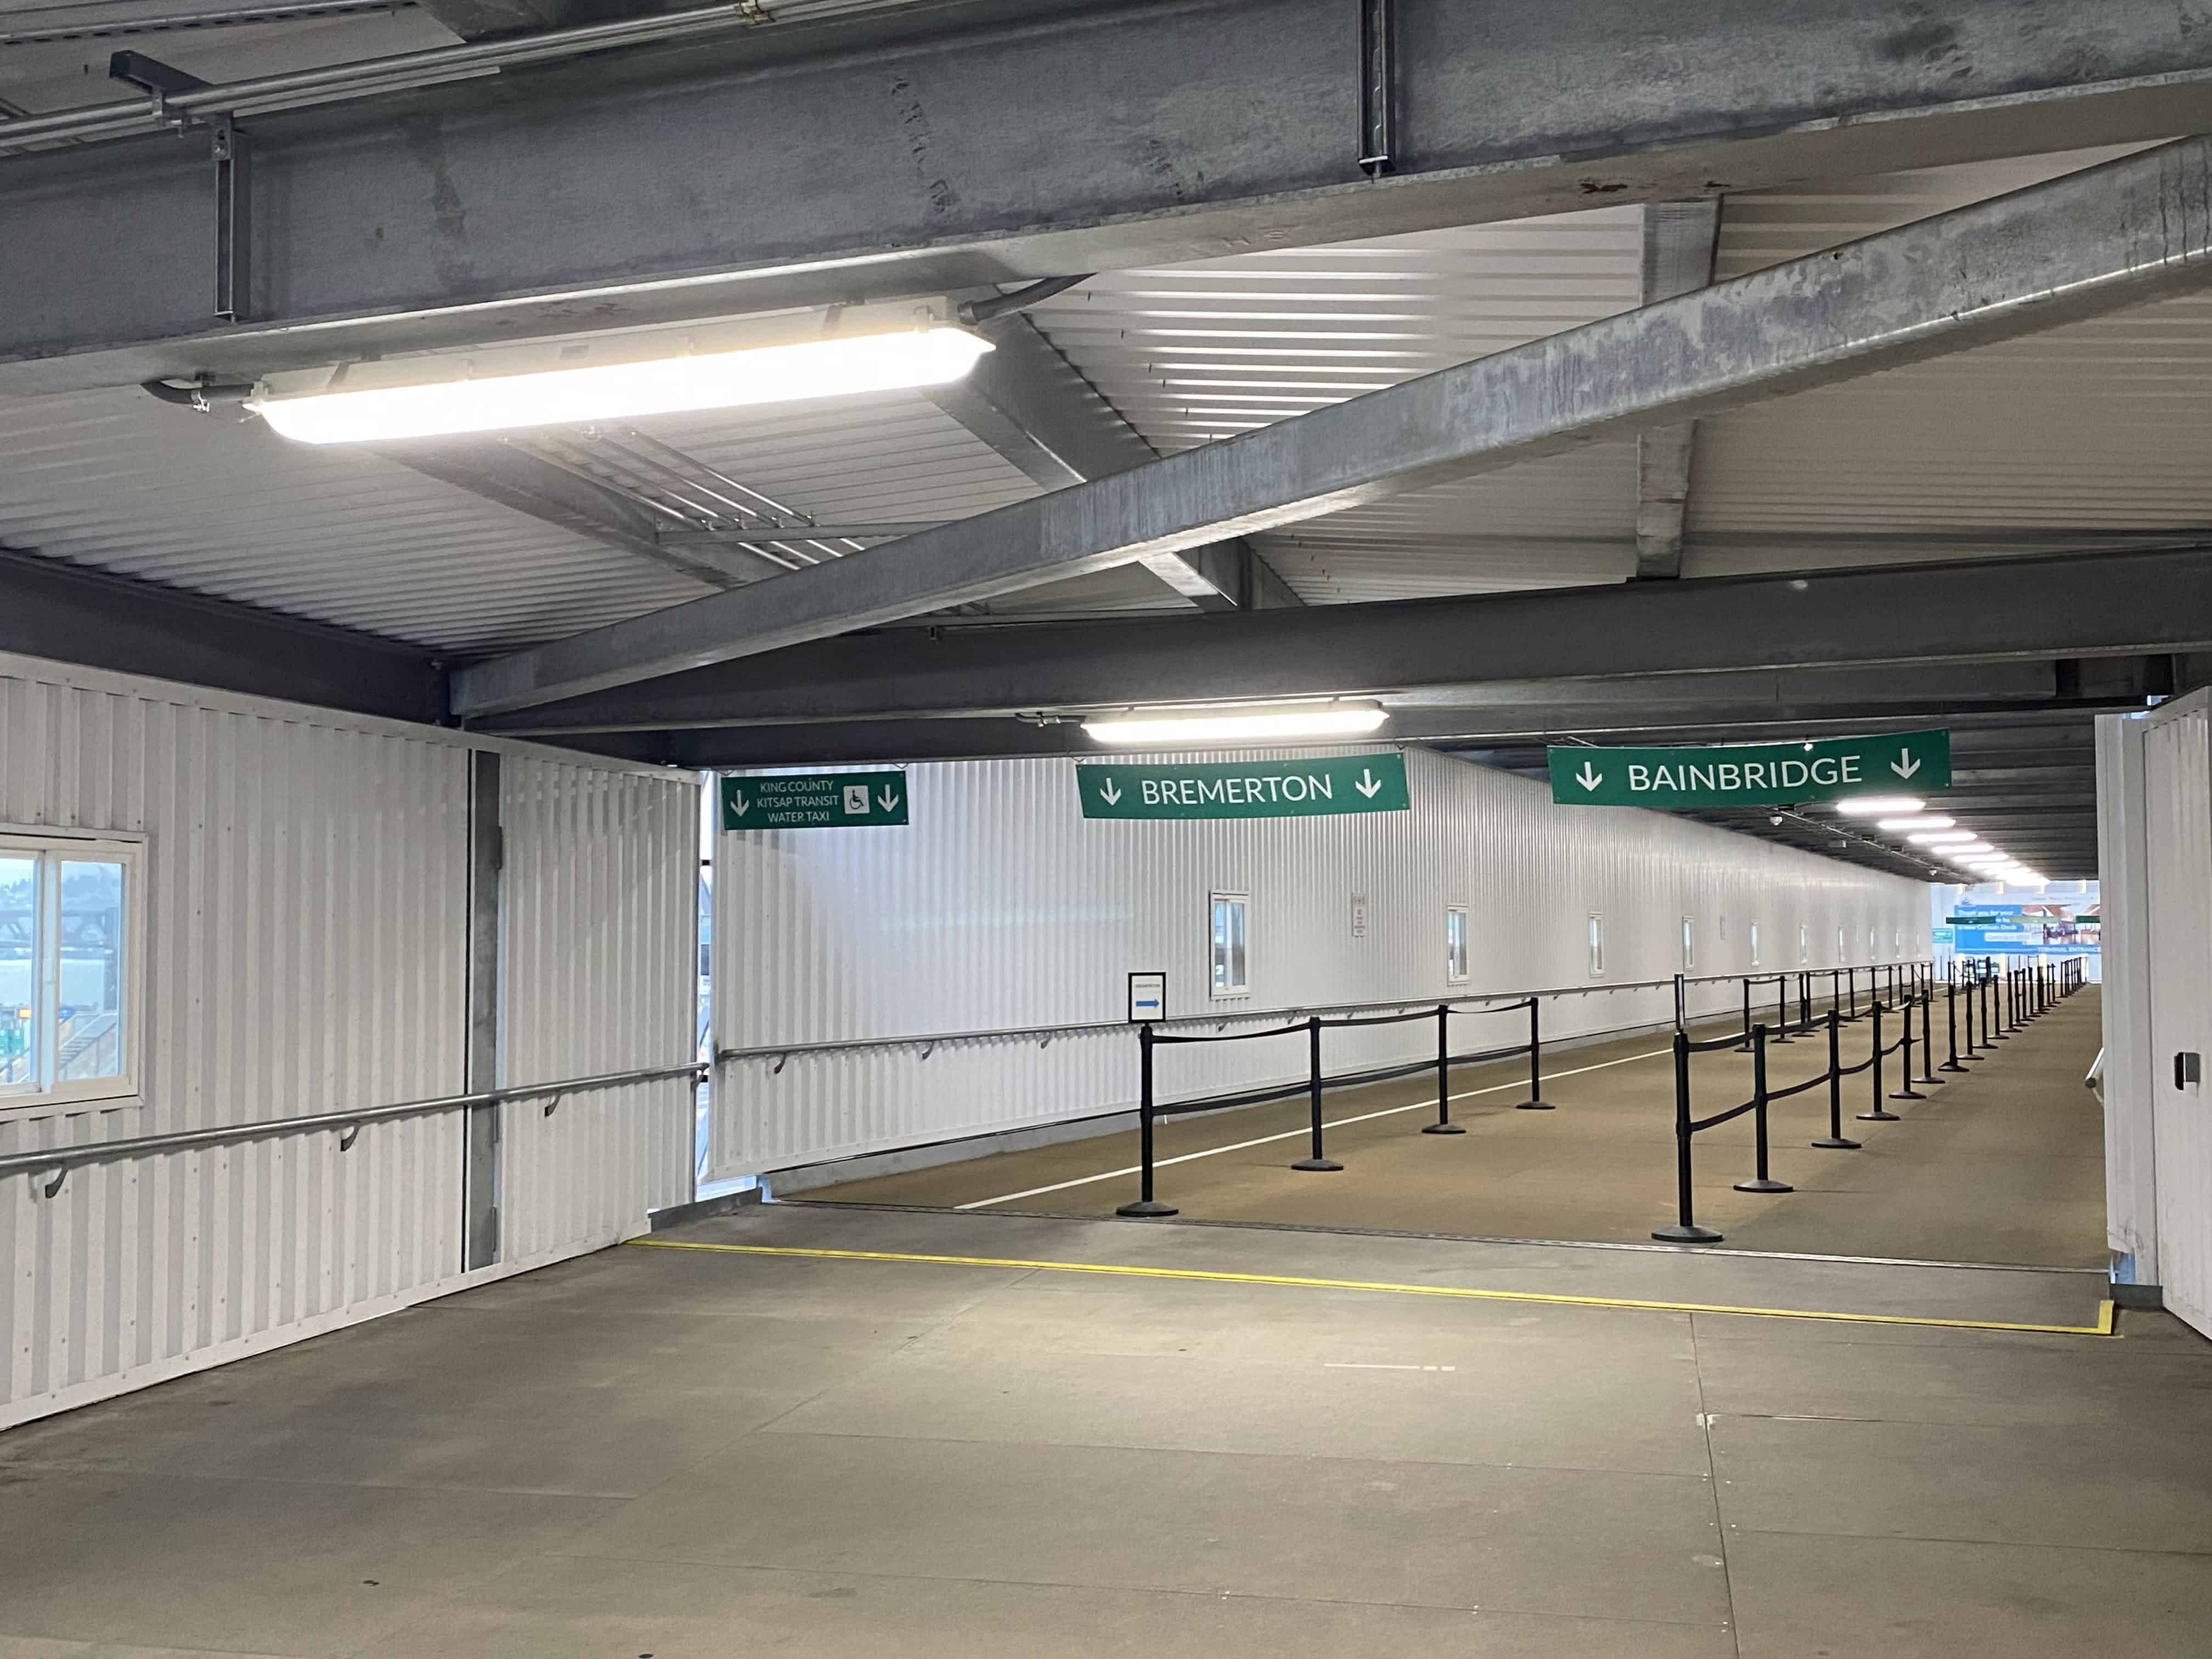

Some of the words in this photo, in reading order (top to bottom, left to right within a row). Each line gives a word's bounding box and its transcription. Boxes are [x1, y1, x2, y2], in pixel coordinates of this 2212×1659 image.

[1628, 755, 1862, 791] BAINBRIDGE
[760, 781, 787, 793] KING
[788, 780, 834, 792] COUNTY
[1141, 774, 1333, 805] BREMERTON
[757, 796, 793, 808] KITSAP
[794, 795, 839, 807] TRANSIT
[768, 811, 804, 823] WATER
[807, 811, 830, 822] TAXI
